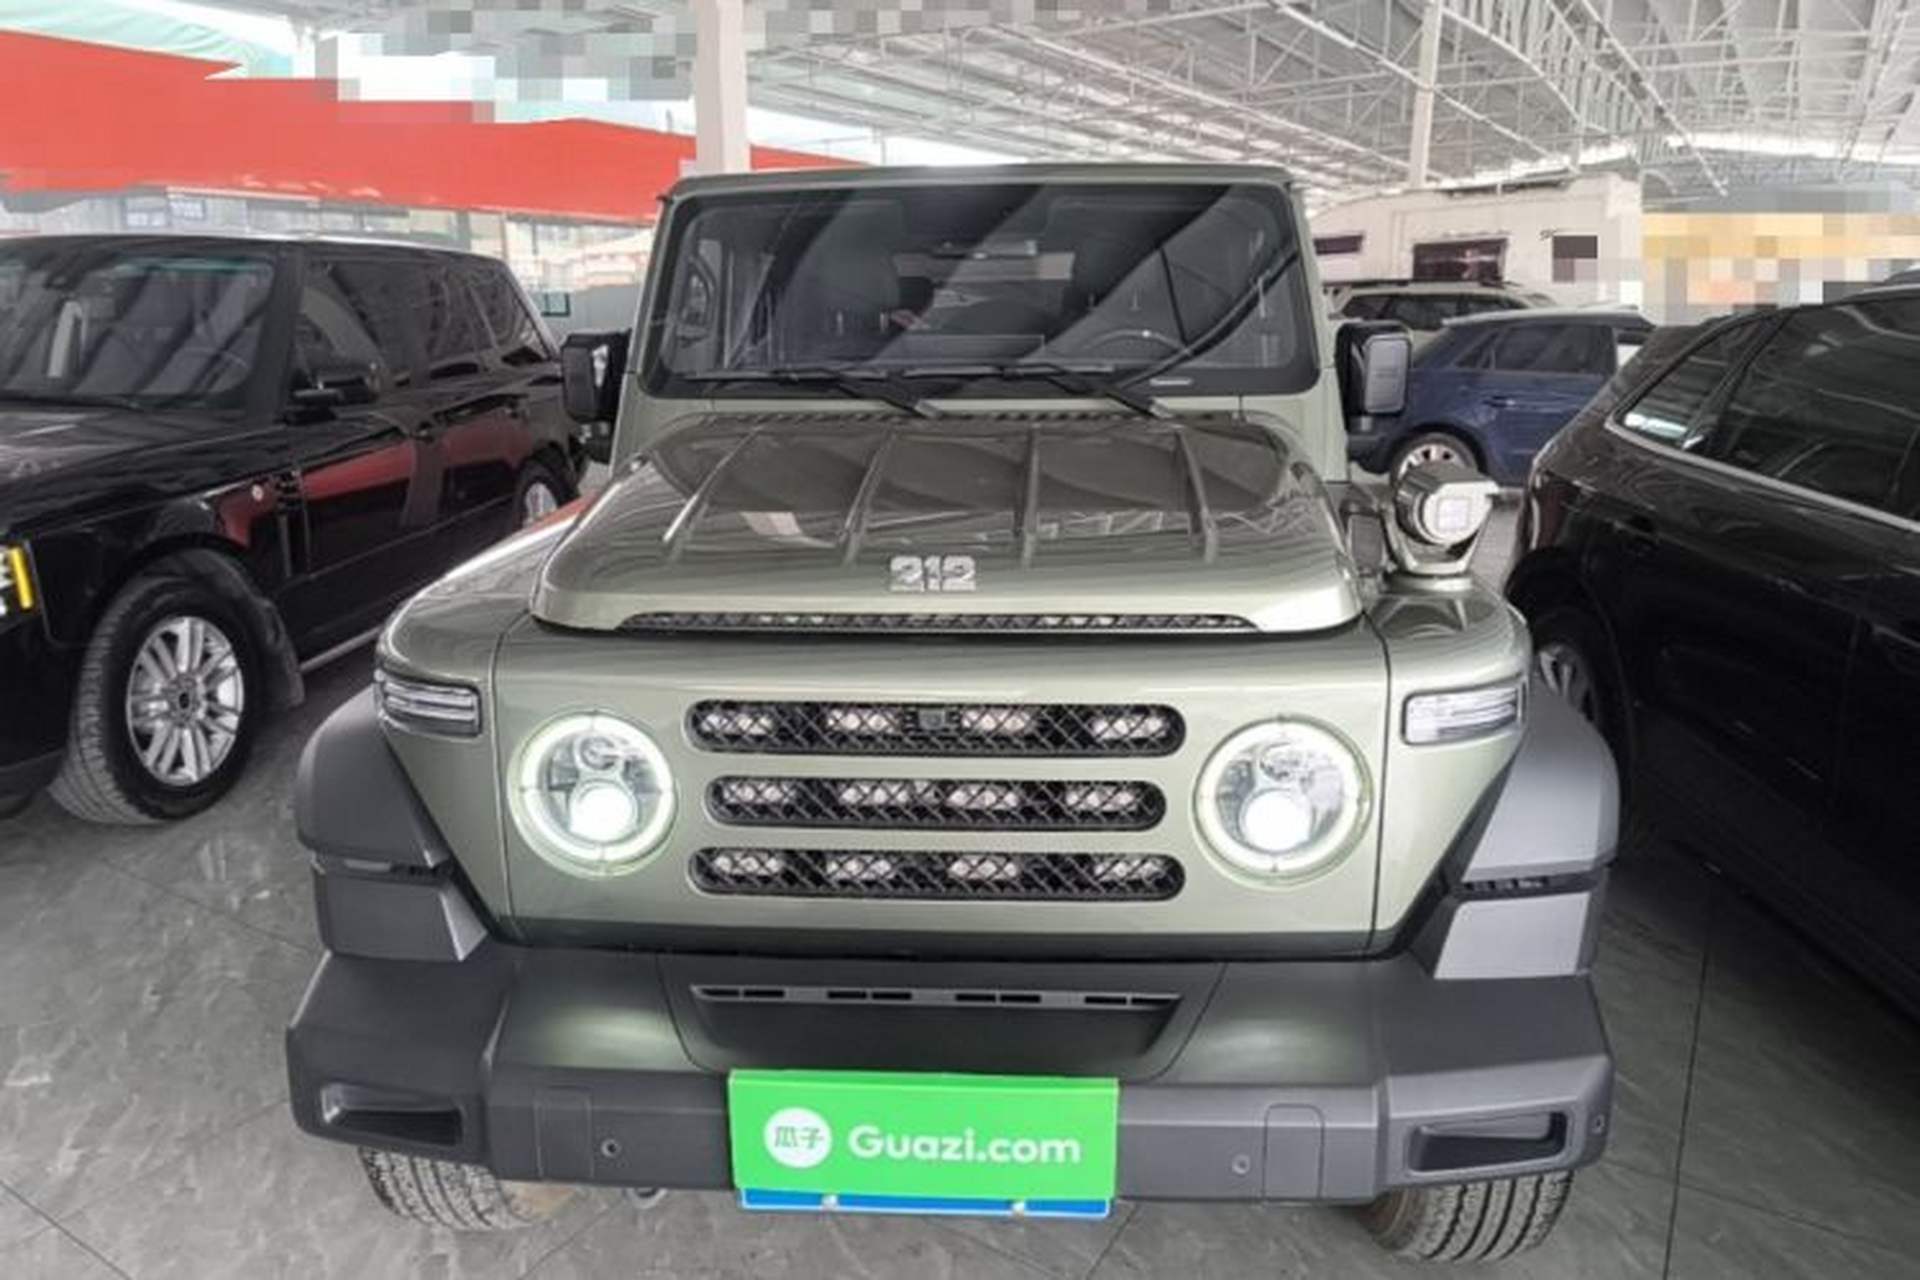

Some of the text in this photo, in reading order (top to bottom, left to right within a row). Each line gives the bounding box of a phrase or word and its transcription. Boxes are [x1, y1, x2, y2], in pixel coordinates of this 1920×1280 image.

[890, 555, 977, 592] 212
[774, 1125, 825, 1150] 瓜子
[848, 1124, 1081, 1164] Guazi.com
